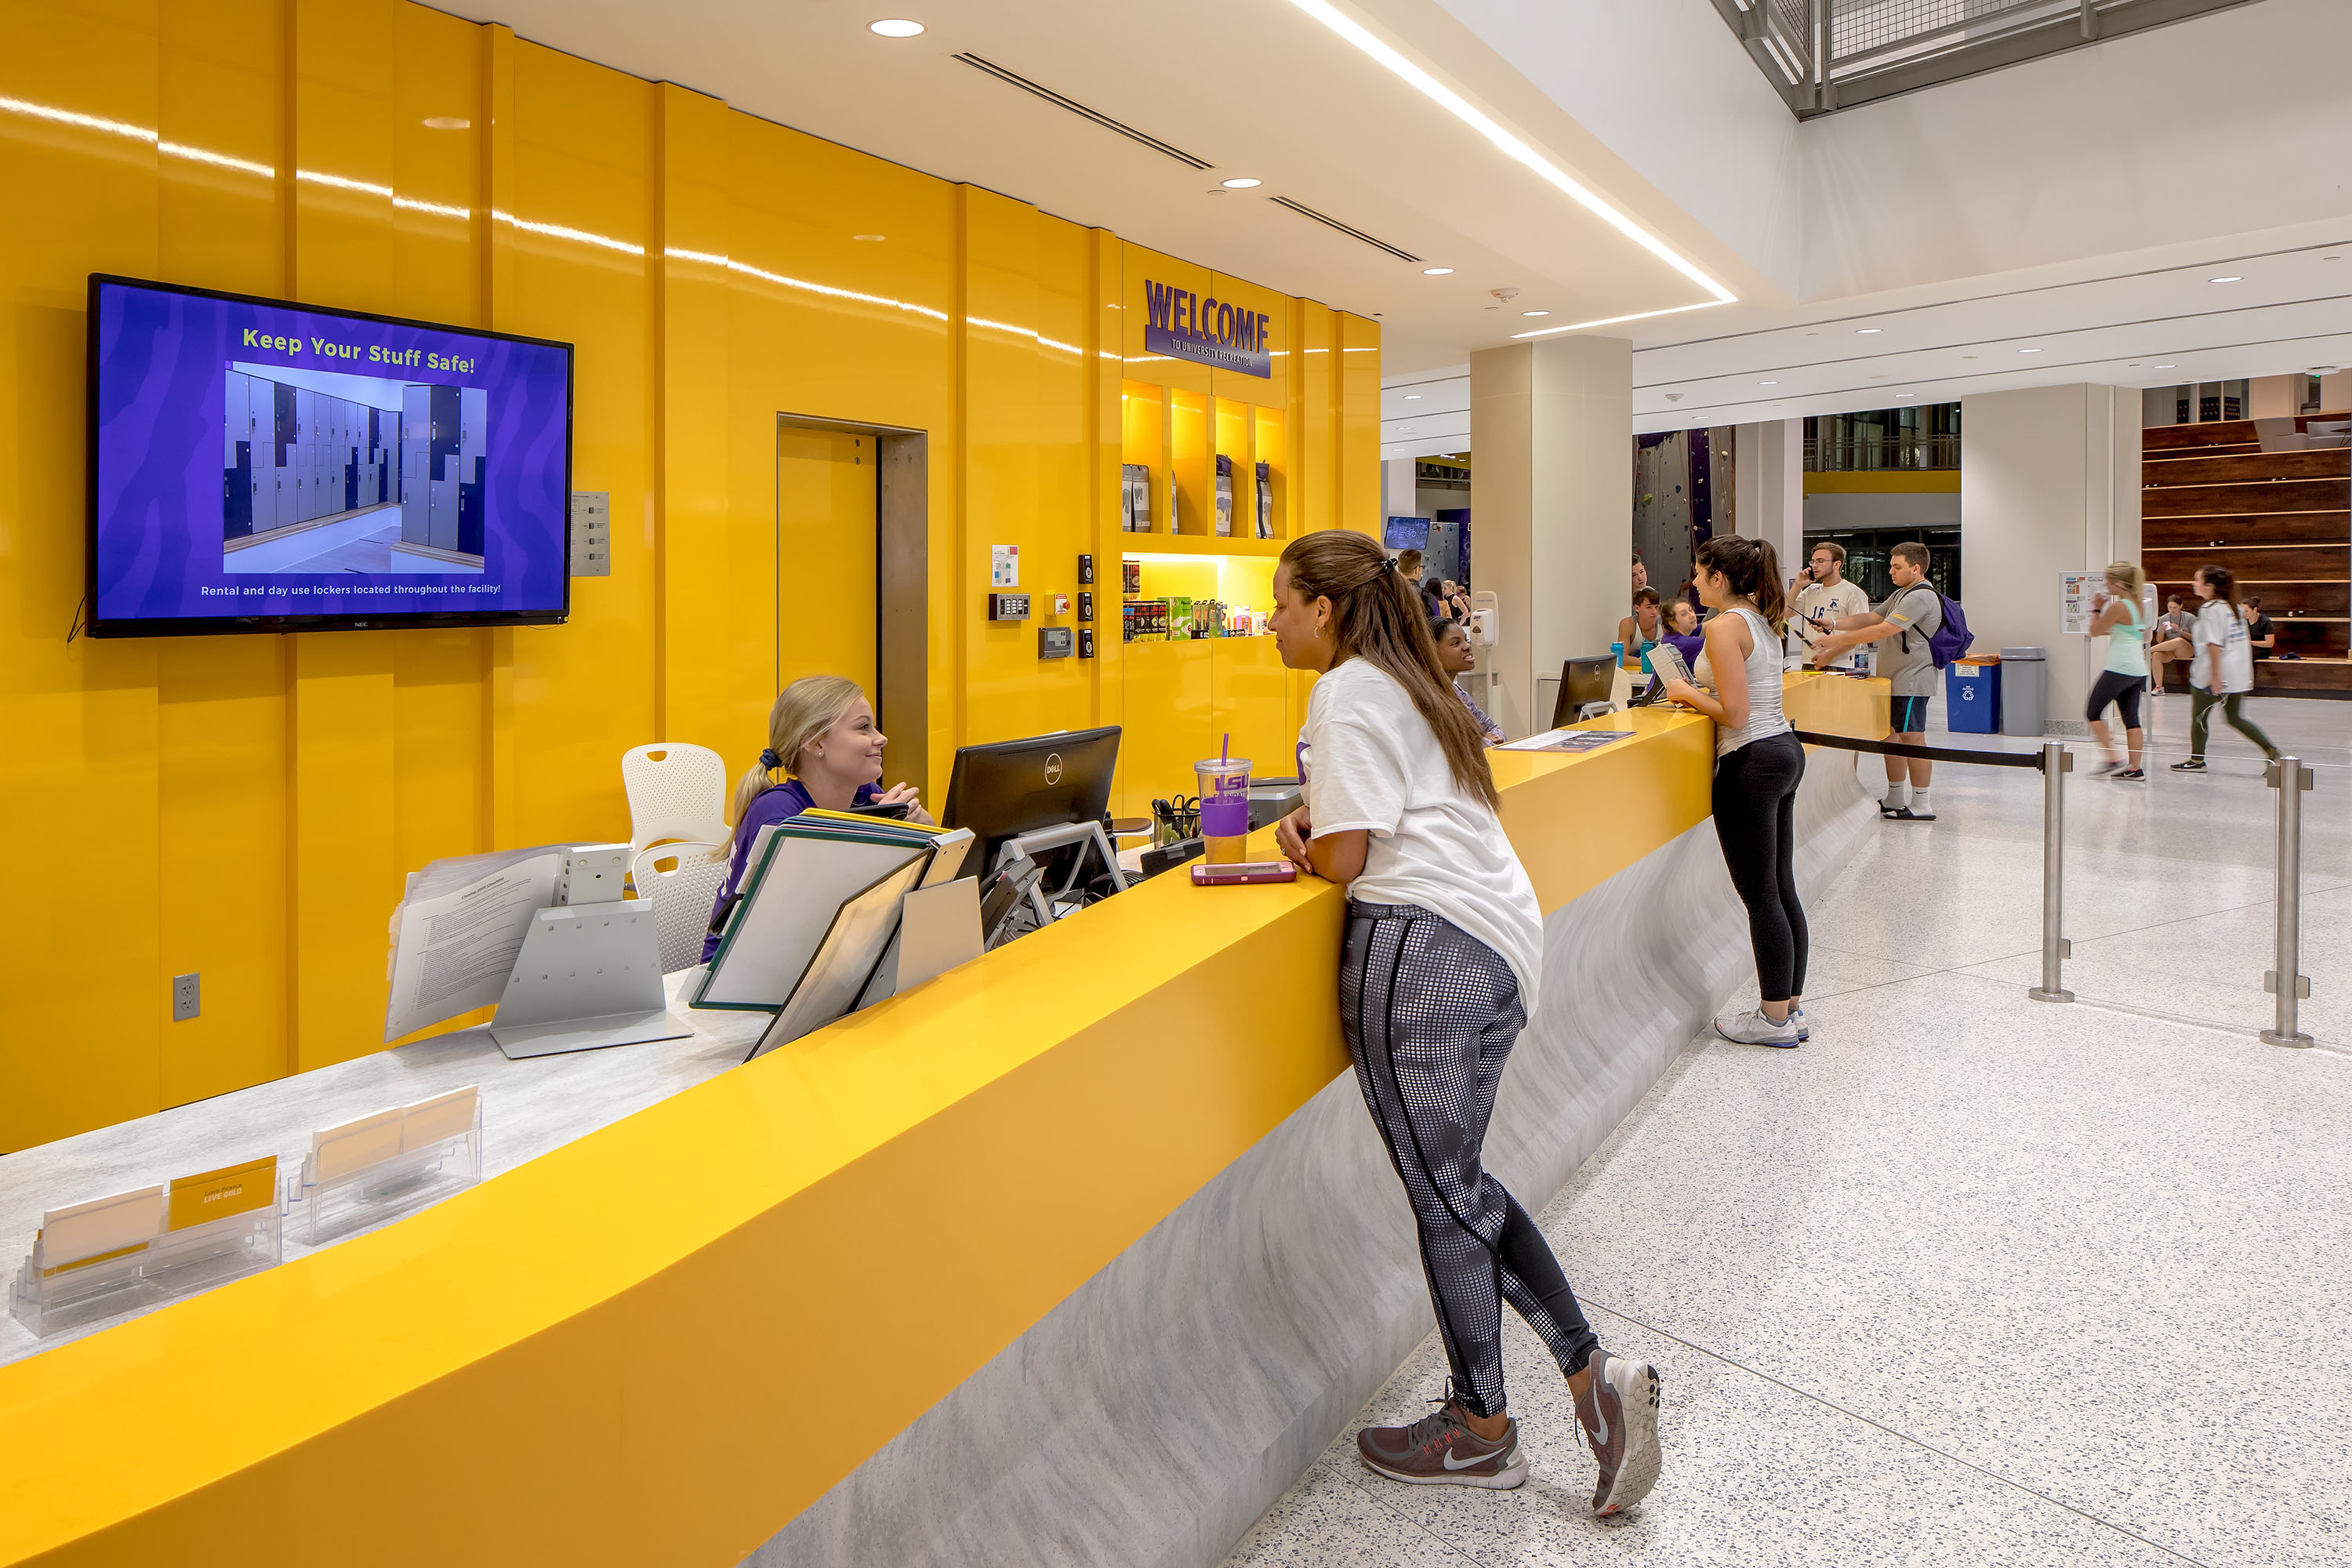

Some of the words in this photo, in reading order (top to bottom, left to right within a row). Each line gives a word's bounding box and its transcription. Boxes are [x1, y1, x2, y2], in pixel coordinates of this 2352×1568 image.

[1145, 279, 1269, 354] WELCOME
[243, 328, 302, 356] Keep
[310, 337, 361, 359] Your
[368, 345, 421, 367] Stuff
[427, 353, 474, 374] Safe!
[1172, 339, 1181, 350] TO
[1182, 341, 1218, 358] UNIVERSITY
[1219, 350, 1253, 367] RECREATION
[201, 586, 239, 596] Rental
[243, 586, 264, 596] and
[268, 586, 288, 597] day
[314, 586, 350, 594] lockers
[354, 585, 390, 594] located
[394, 585, 448, 595] throughout
[451, 585, 466, 593] the
[468, 584, 501, 594] facility!
[1047, 764, 1060, 774] DELL
[1215, 774, 1248, 791] LSU
[204, 1192, 222, 1203] LIVE
[223, 1187, 241, 1198] GOLD
